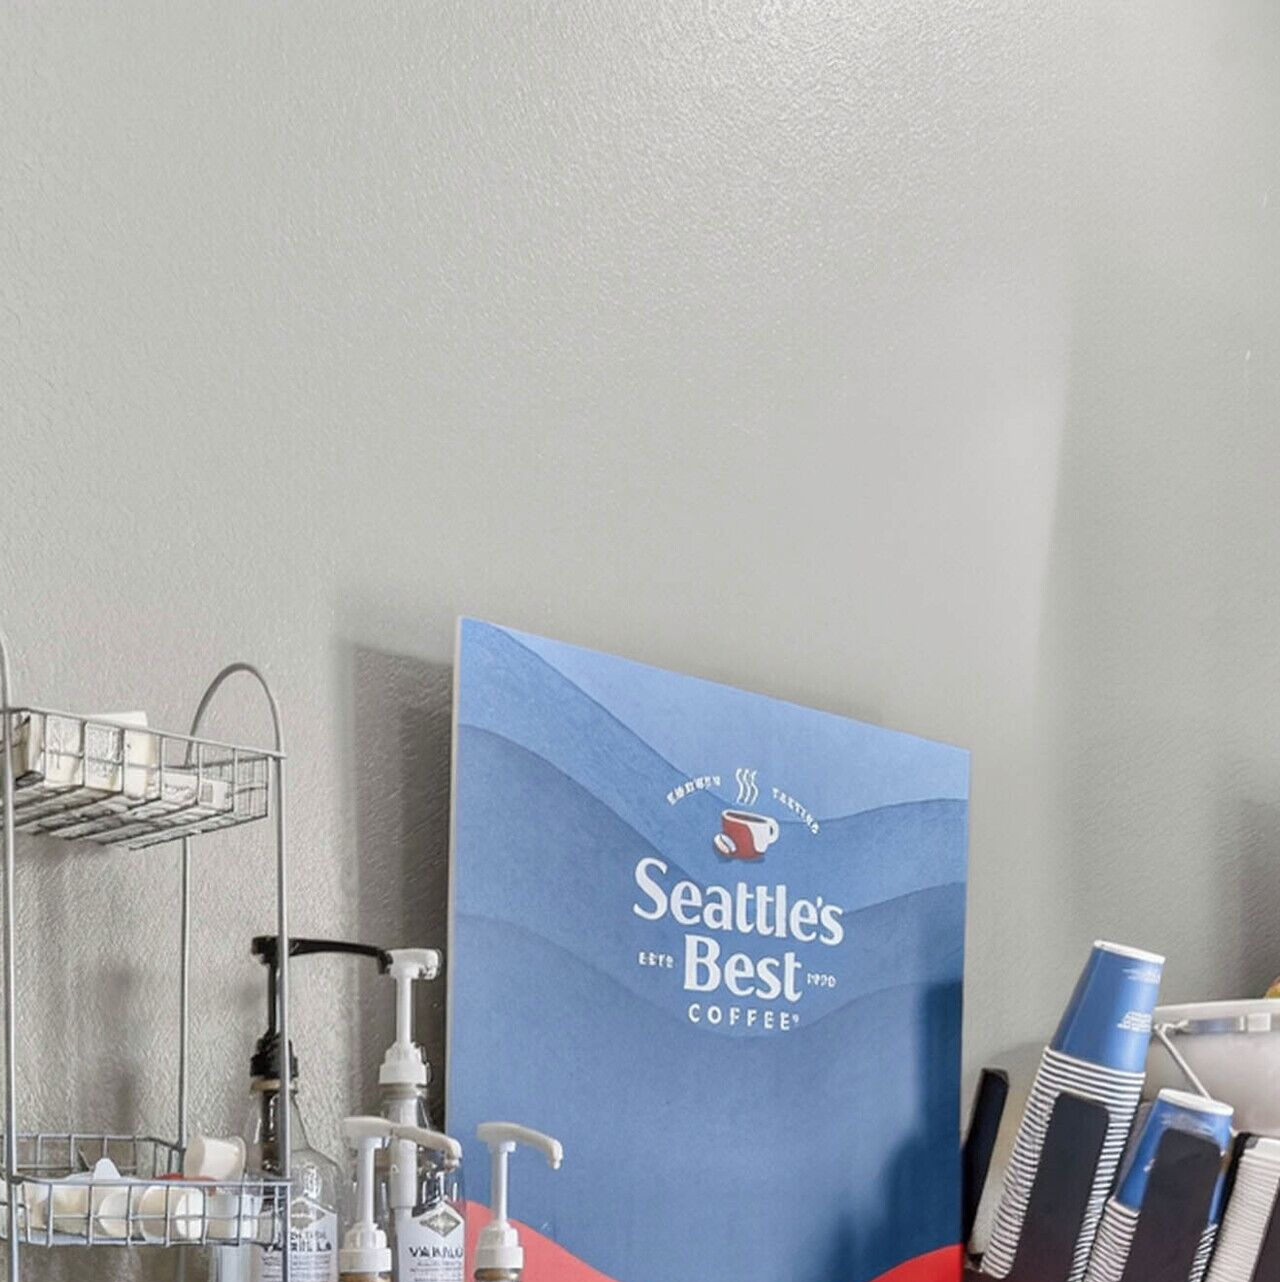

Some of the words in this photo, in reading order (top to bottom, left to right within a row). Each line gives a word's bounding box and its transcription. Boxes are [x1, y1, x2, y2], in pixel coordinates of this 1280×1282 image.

[632, 857, 844, 946] Seattle's
[683, 933, 803, 1003] Best
[688, 1003, 792, 1031] COFFEE
